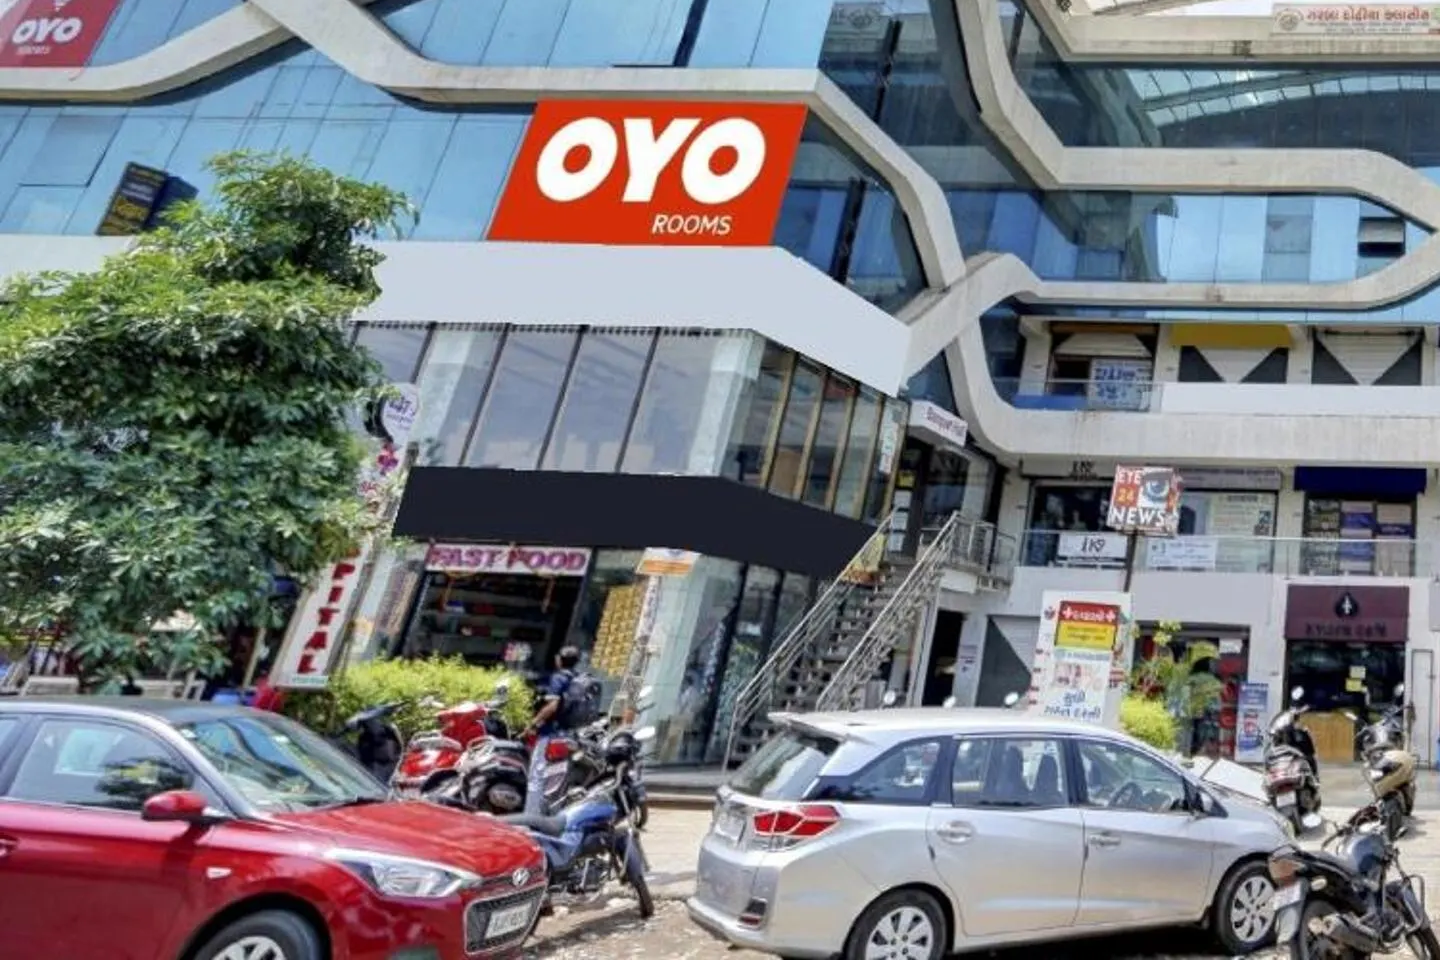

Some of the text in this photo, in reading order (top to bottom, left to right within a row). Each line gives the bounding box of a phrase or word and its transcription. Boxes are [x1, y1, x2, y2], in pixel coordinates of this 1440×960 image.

[12, 17, 82, 44] OYO
[536, 117, 766, 205] OYO
[651, 214, 732, 236] ROOMS
[1117, 470, 1142, 485] EYE
[1115, 486, 1134, 505] 24
[1111, 506, 1165, 528] NEWS
[426, 543, 588, 571] FAST FOOD
